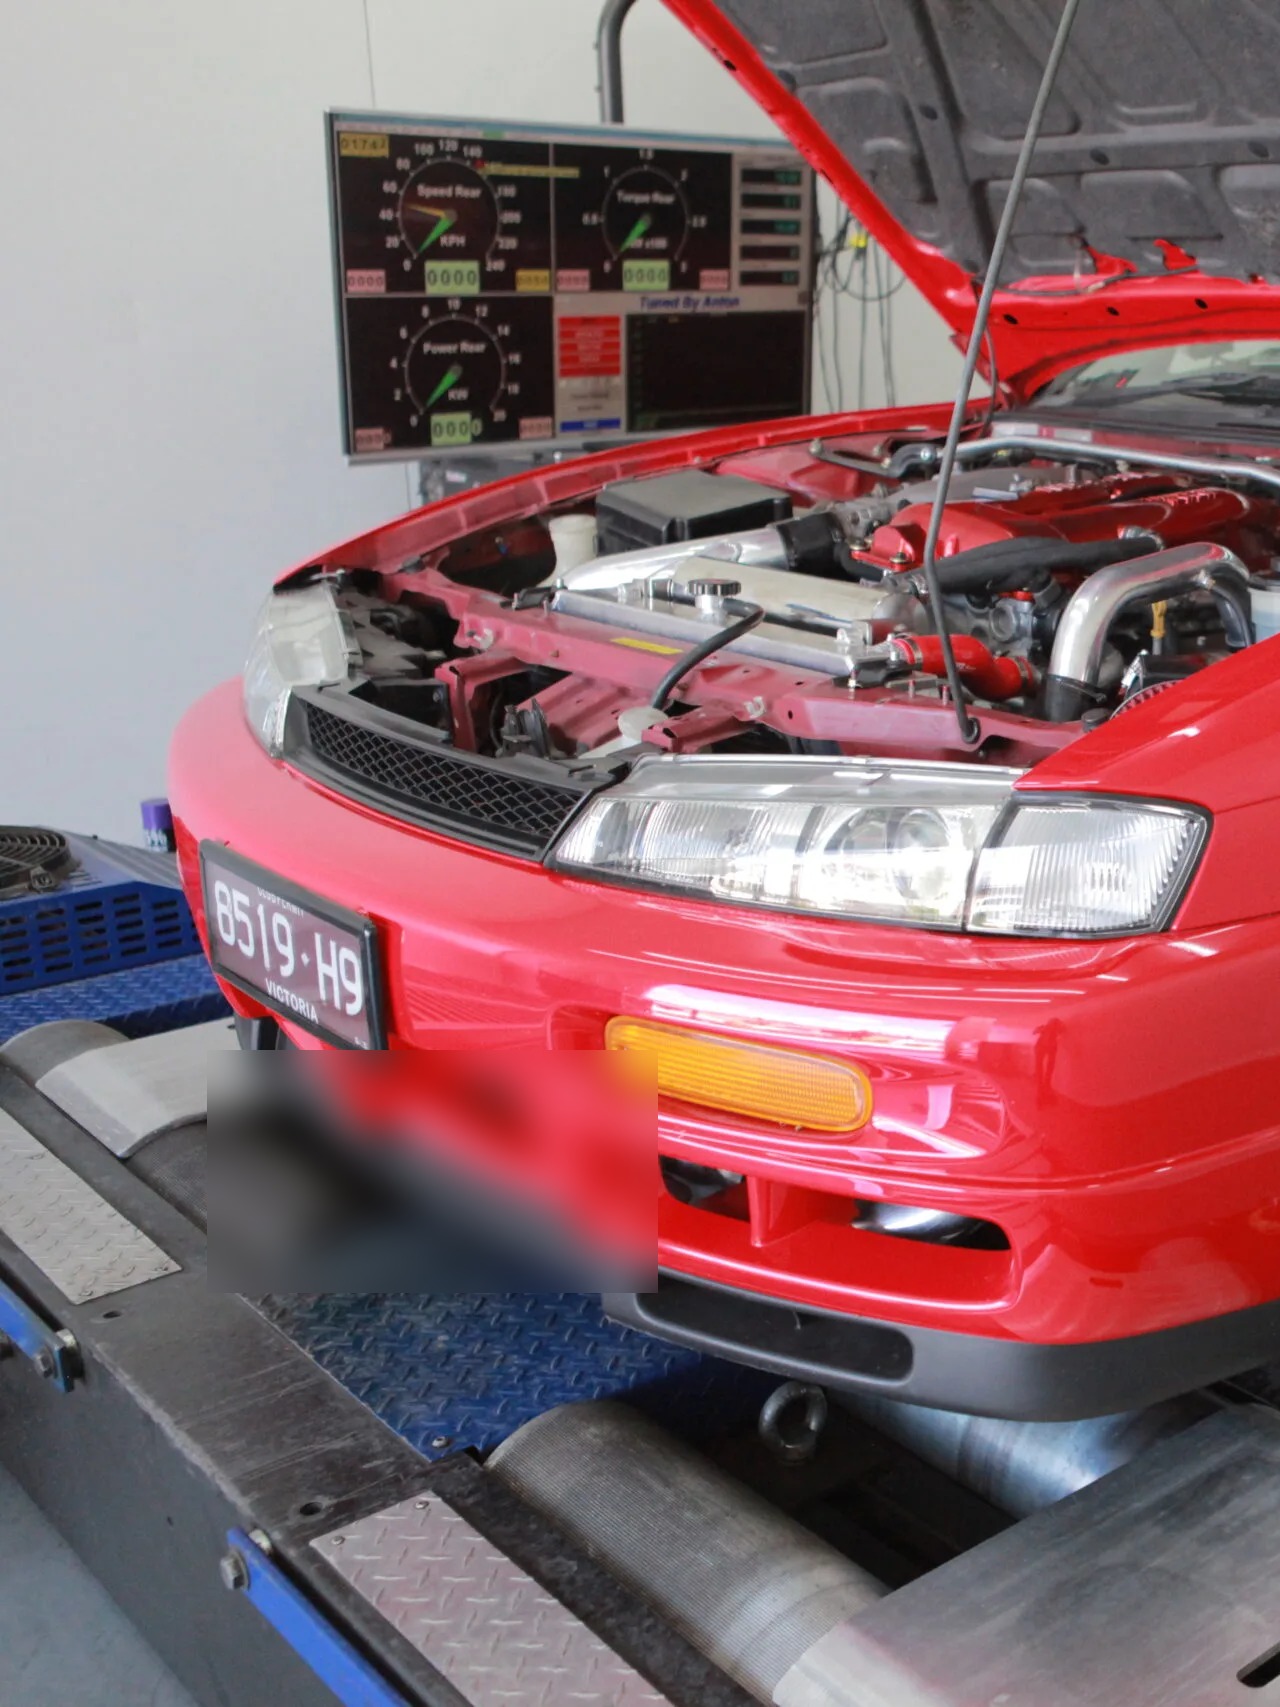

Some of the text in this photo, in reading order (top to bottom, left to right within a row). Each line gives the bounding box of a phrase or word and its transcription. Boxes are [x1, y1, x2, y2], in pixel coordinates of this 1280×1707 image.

[415, 143, 434, 156] 100
[439, 139, 458, 152] 120
[396, 159, 410, 170] 80
[417, 184, 481, 200] Speed Rear
[617, 189, 650, 205] Torque
[379, 210, 393, 221] 40
[386, 237, 399, 248] 20
[440, 235, 465, 247] KPH
[403, 260, 411, 271] 0
[349, 275, 385, 287] 0000
[427, 269, 477, 285] 0000
[624, 270, 667, 283] 0000
[448, 299, 461, 310] 10
[641, 296, 680, 309] Tuned
[682, 296, 700, 312] By
[476, 305, 488, 317] 12
[423, 342, 486, 354] Power Rear
[433, 418, 482, 437] 0000
[264, 976, 319, 1025] VICTORIA
